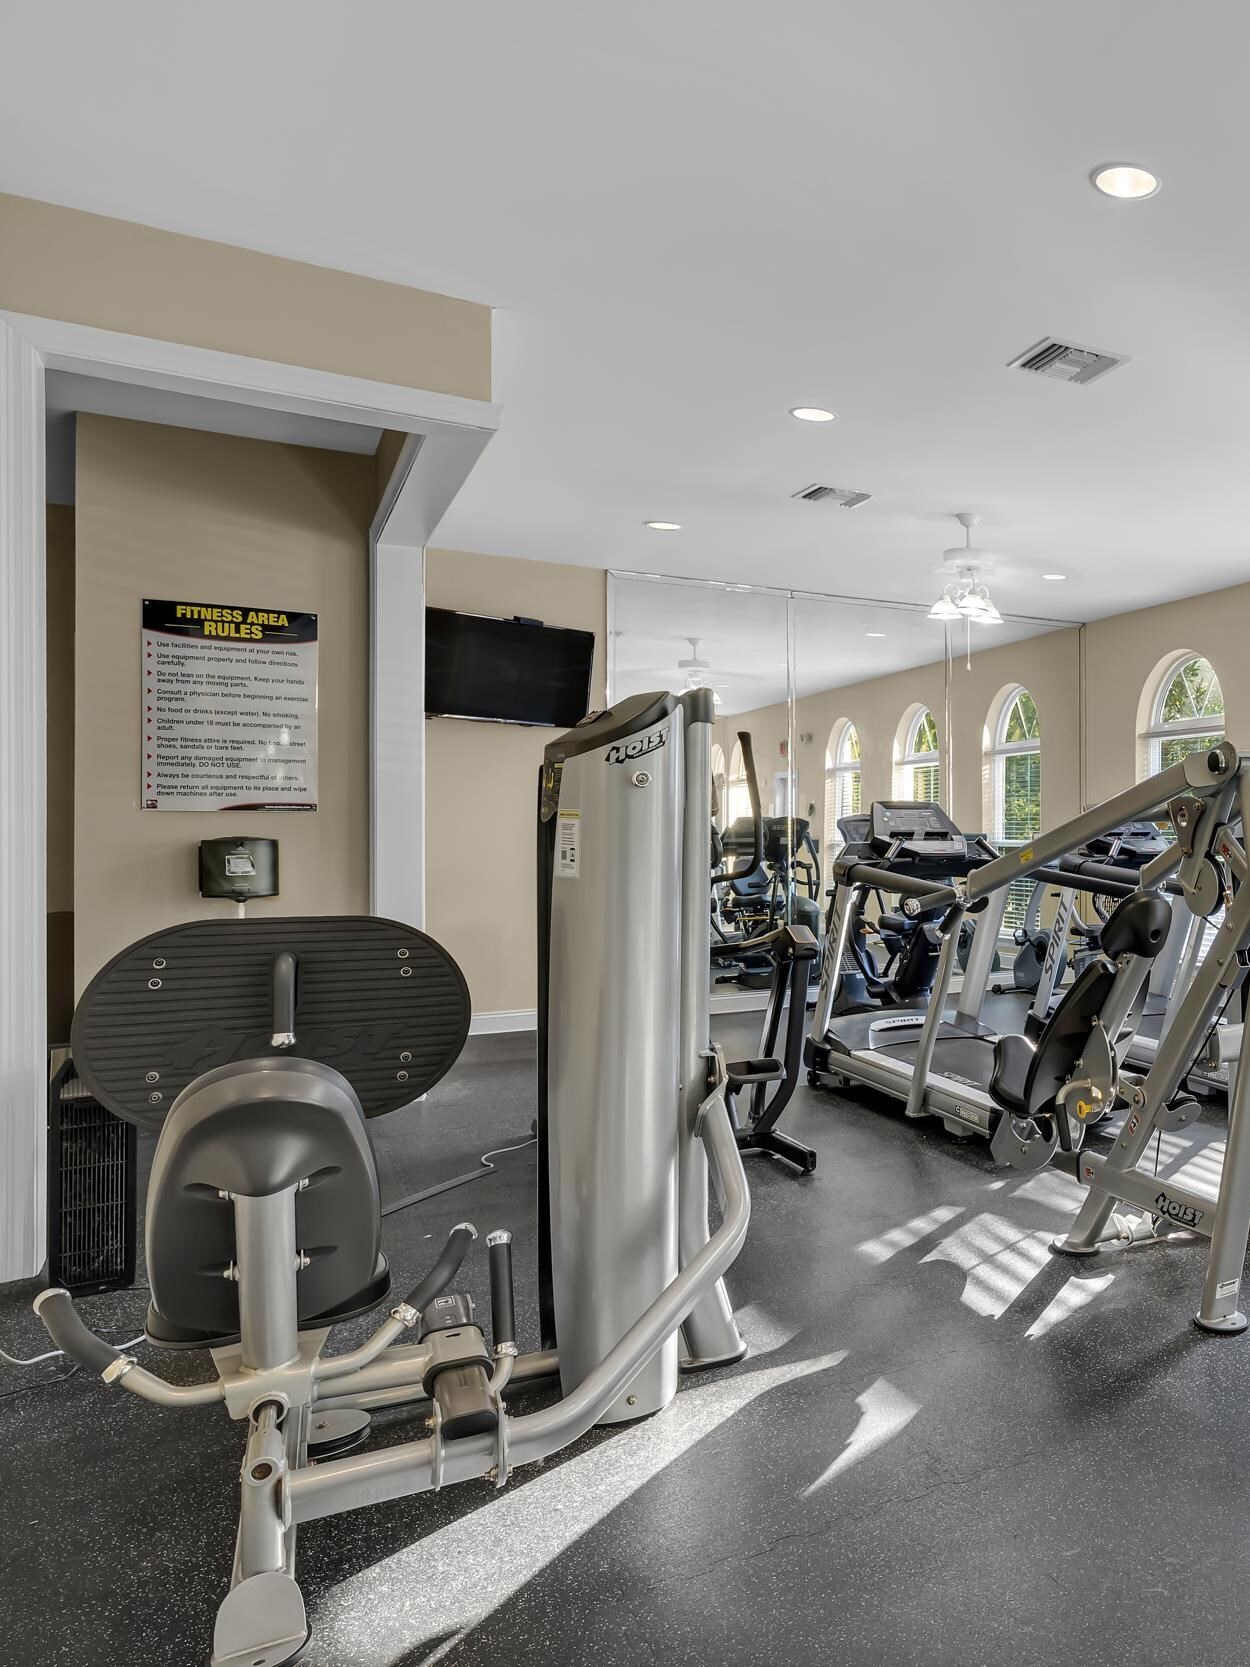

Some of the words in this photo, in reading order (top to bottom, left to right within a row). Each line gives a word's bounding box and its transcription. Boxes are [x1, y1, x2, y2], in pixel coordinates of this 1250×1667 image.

[176, 605, 243, 622] FITNESS
[247, 611, 289, 627] AREA
[204, 621, 263, 640] RULES
[243, 693, 273, 701] beginning
[605, 727, 670, 765] HOIST
[820, 904, 841, 998] SPIRIT
[1044, 894, 1068, 983] SPIRIT
[885, 1017, 920, 1025] SPIRIT
[1155, 1192, 1204, 1227] HOIST
